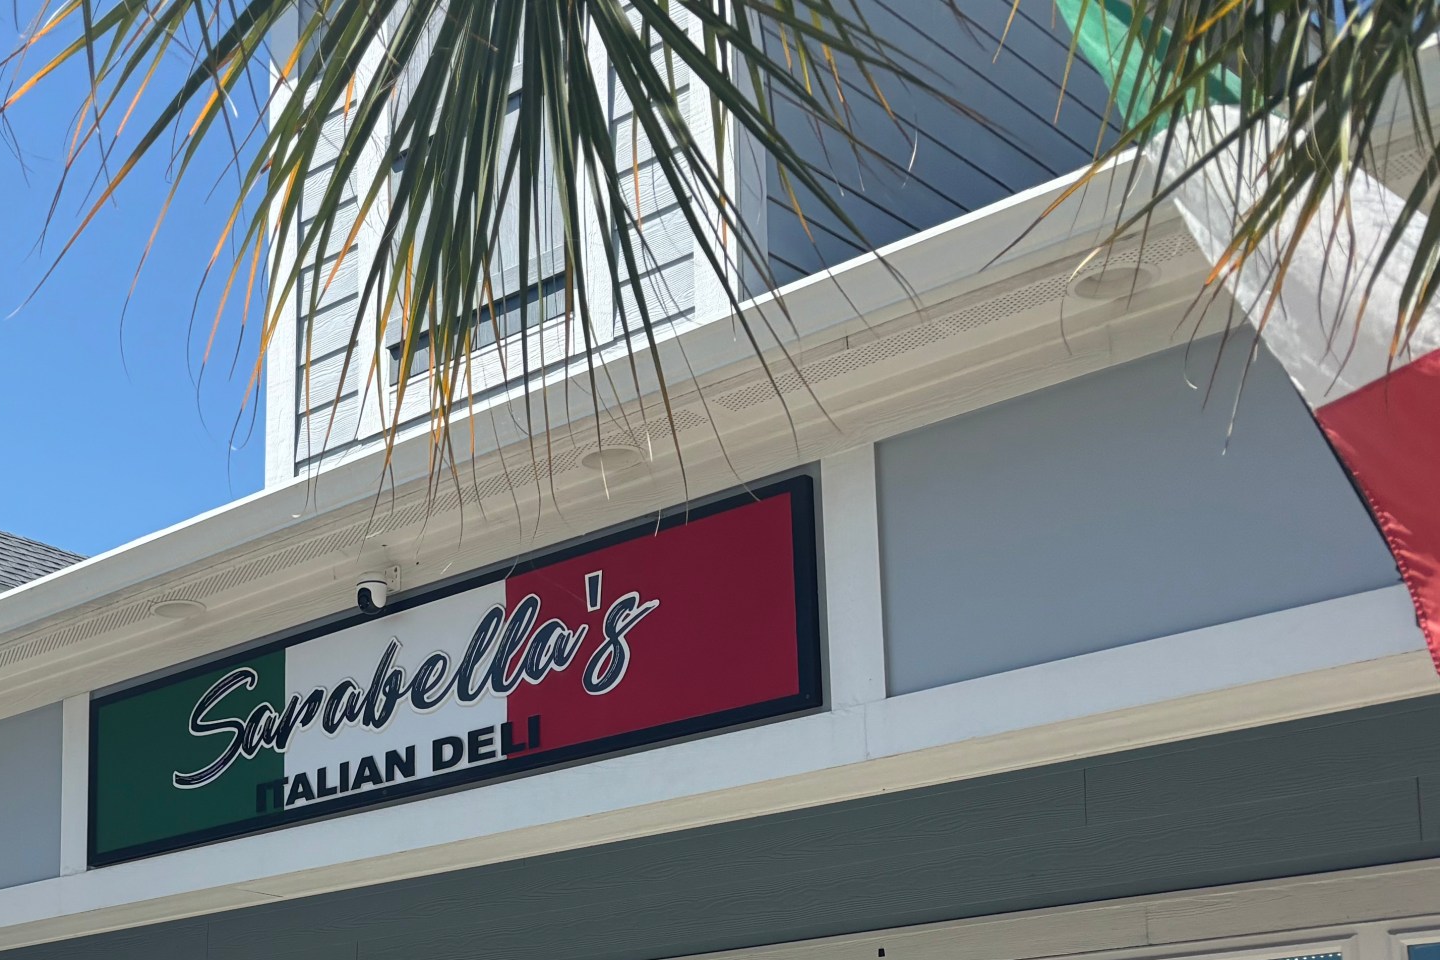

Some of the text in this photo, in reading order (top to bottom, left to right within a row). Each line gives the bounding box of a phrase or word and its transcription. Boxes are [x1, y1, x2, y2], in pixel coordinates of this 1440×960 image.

[172, 571, 659, 787] Sarabella's
[256, 714, 541, 813] ITALIAN DELI
